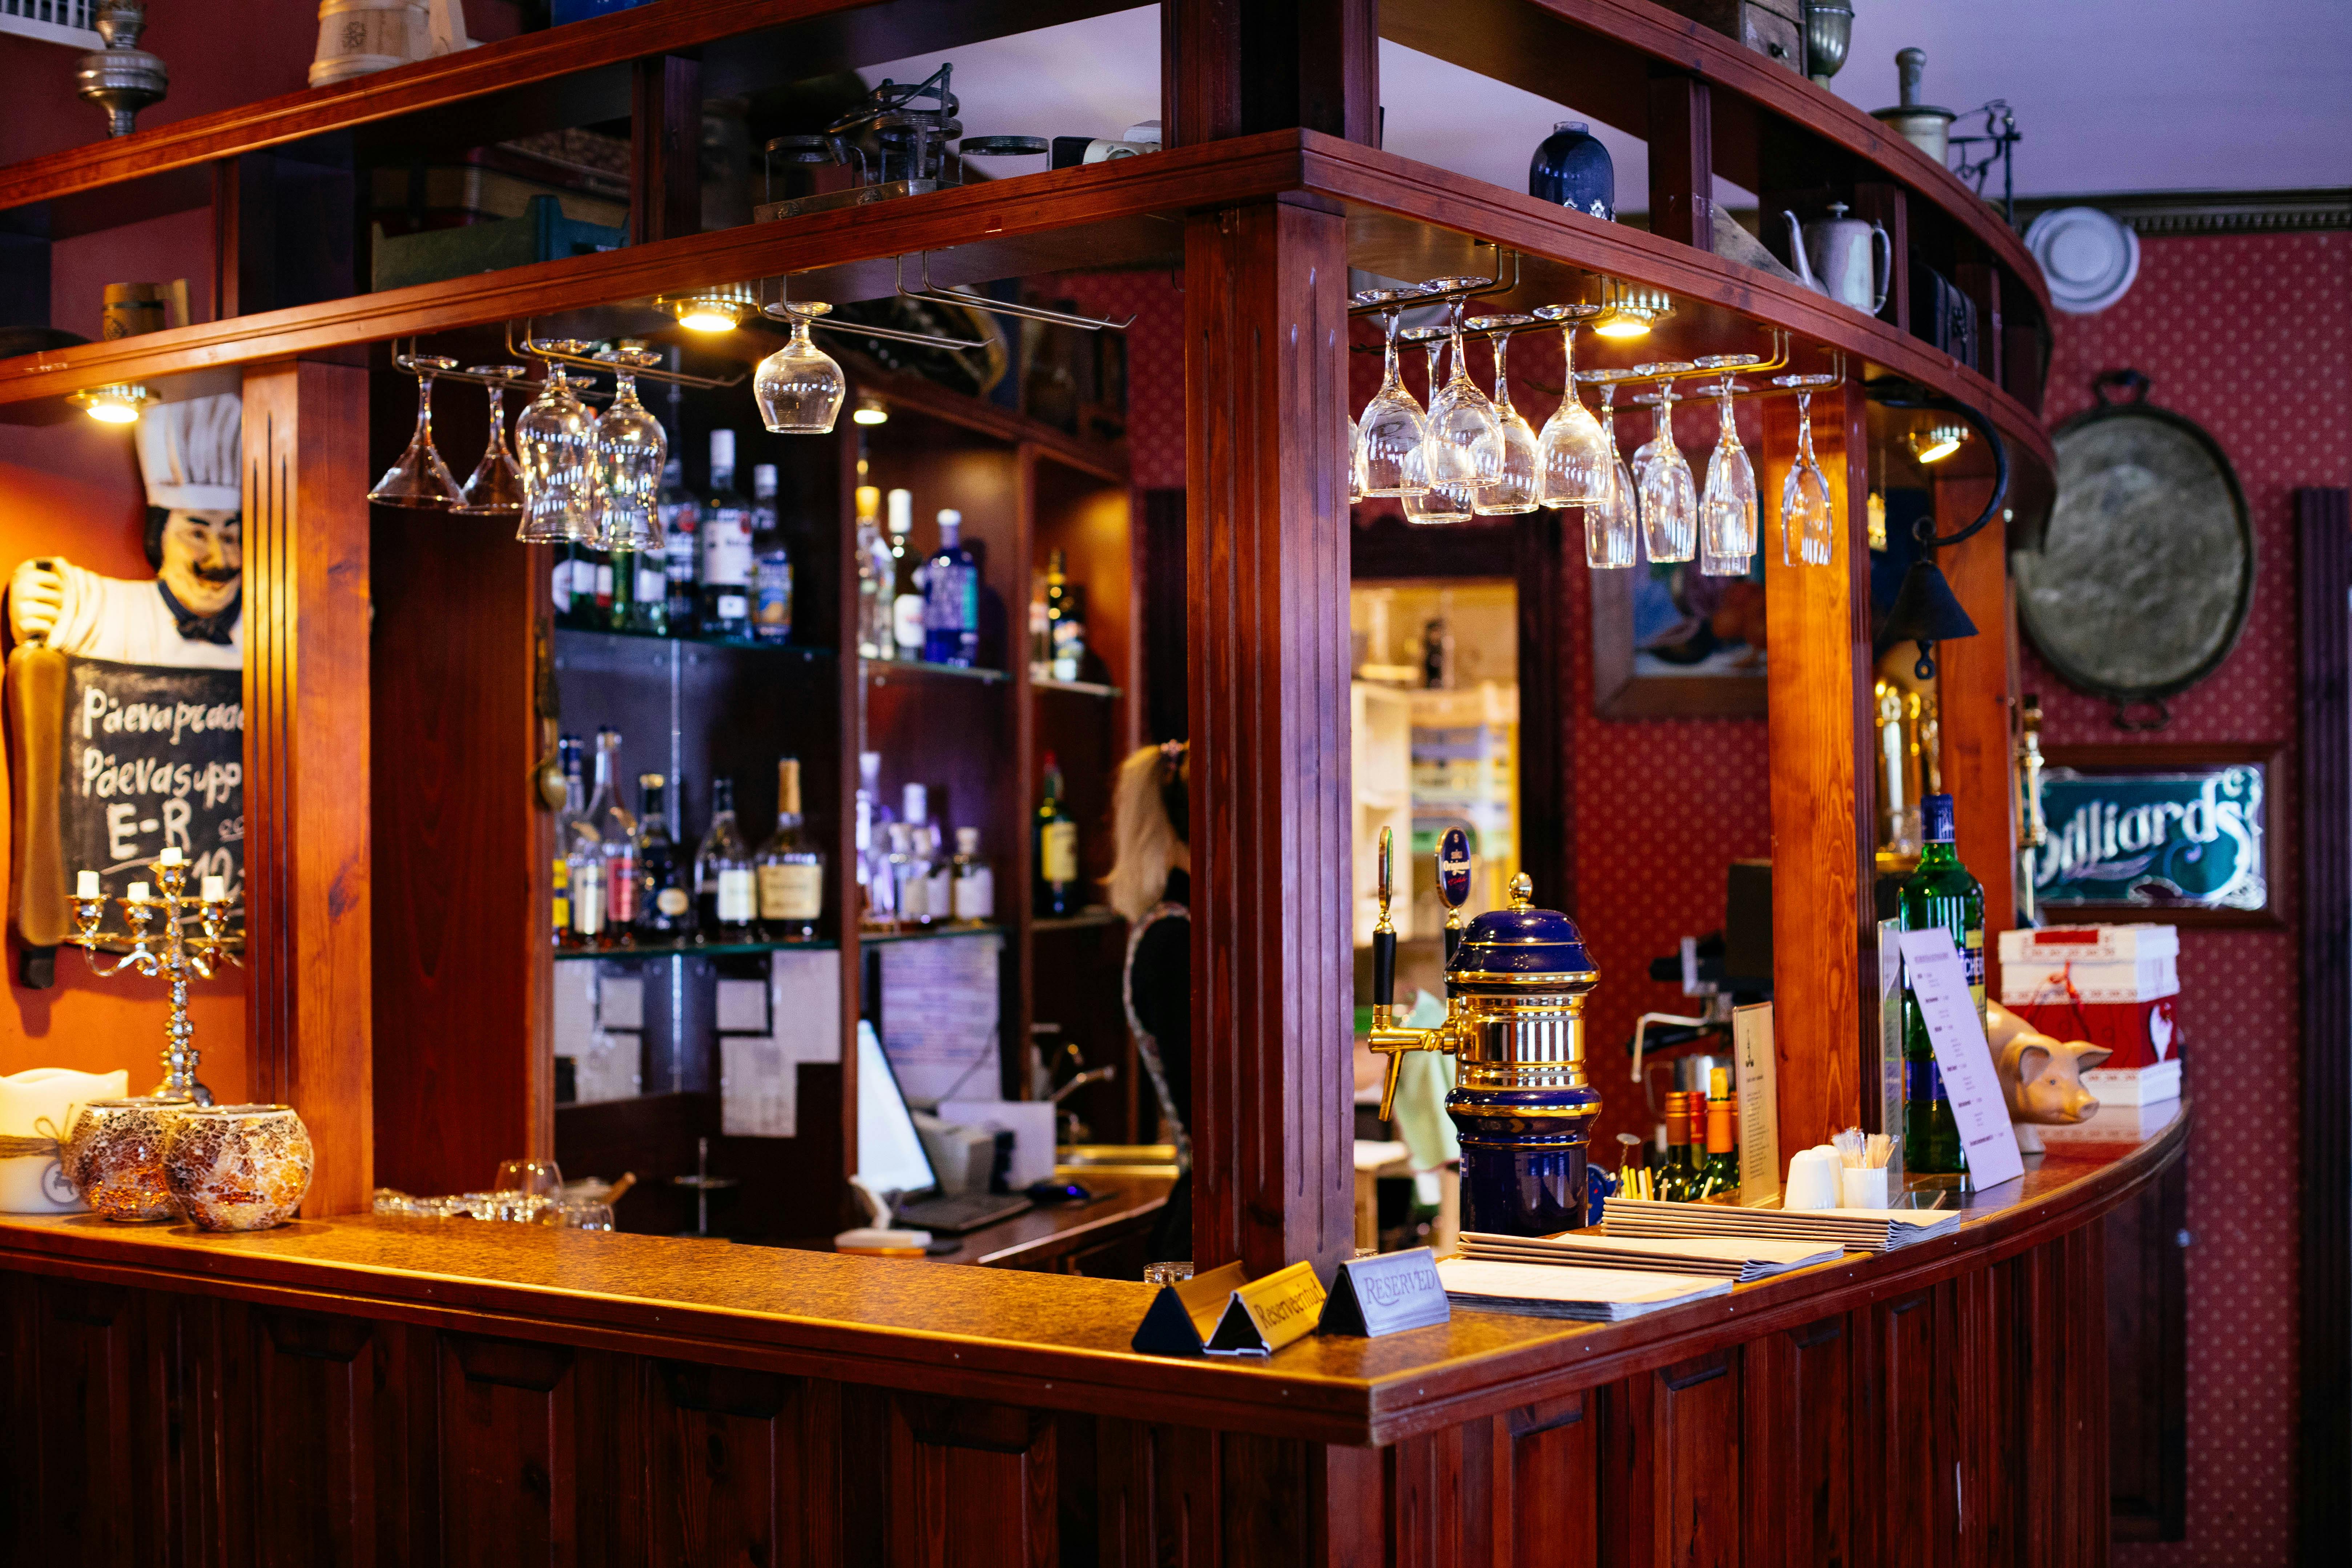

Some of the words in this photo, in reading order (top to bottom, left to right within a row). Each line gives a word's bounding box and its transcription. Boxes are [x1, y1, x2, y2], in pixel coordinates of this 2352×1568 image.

[82, 746, 242, 811] Päevasupp
[106, 797, 192, 860] E-R
[1443, 860, 1470, 876] Original
[1364, 1269, 1435, 1306] RESERVED
